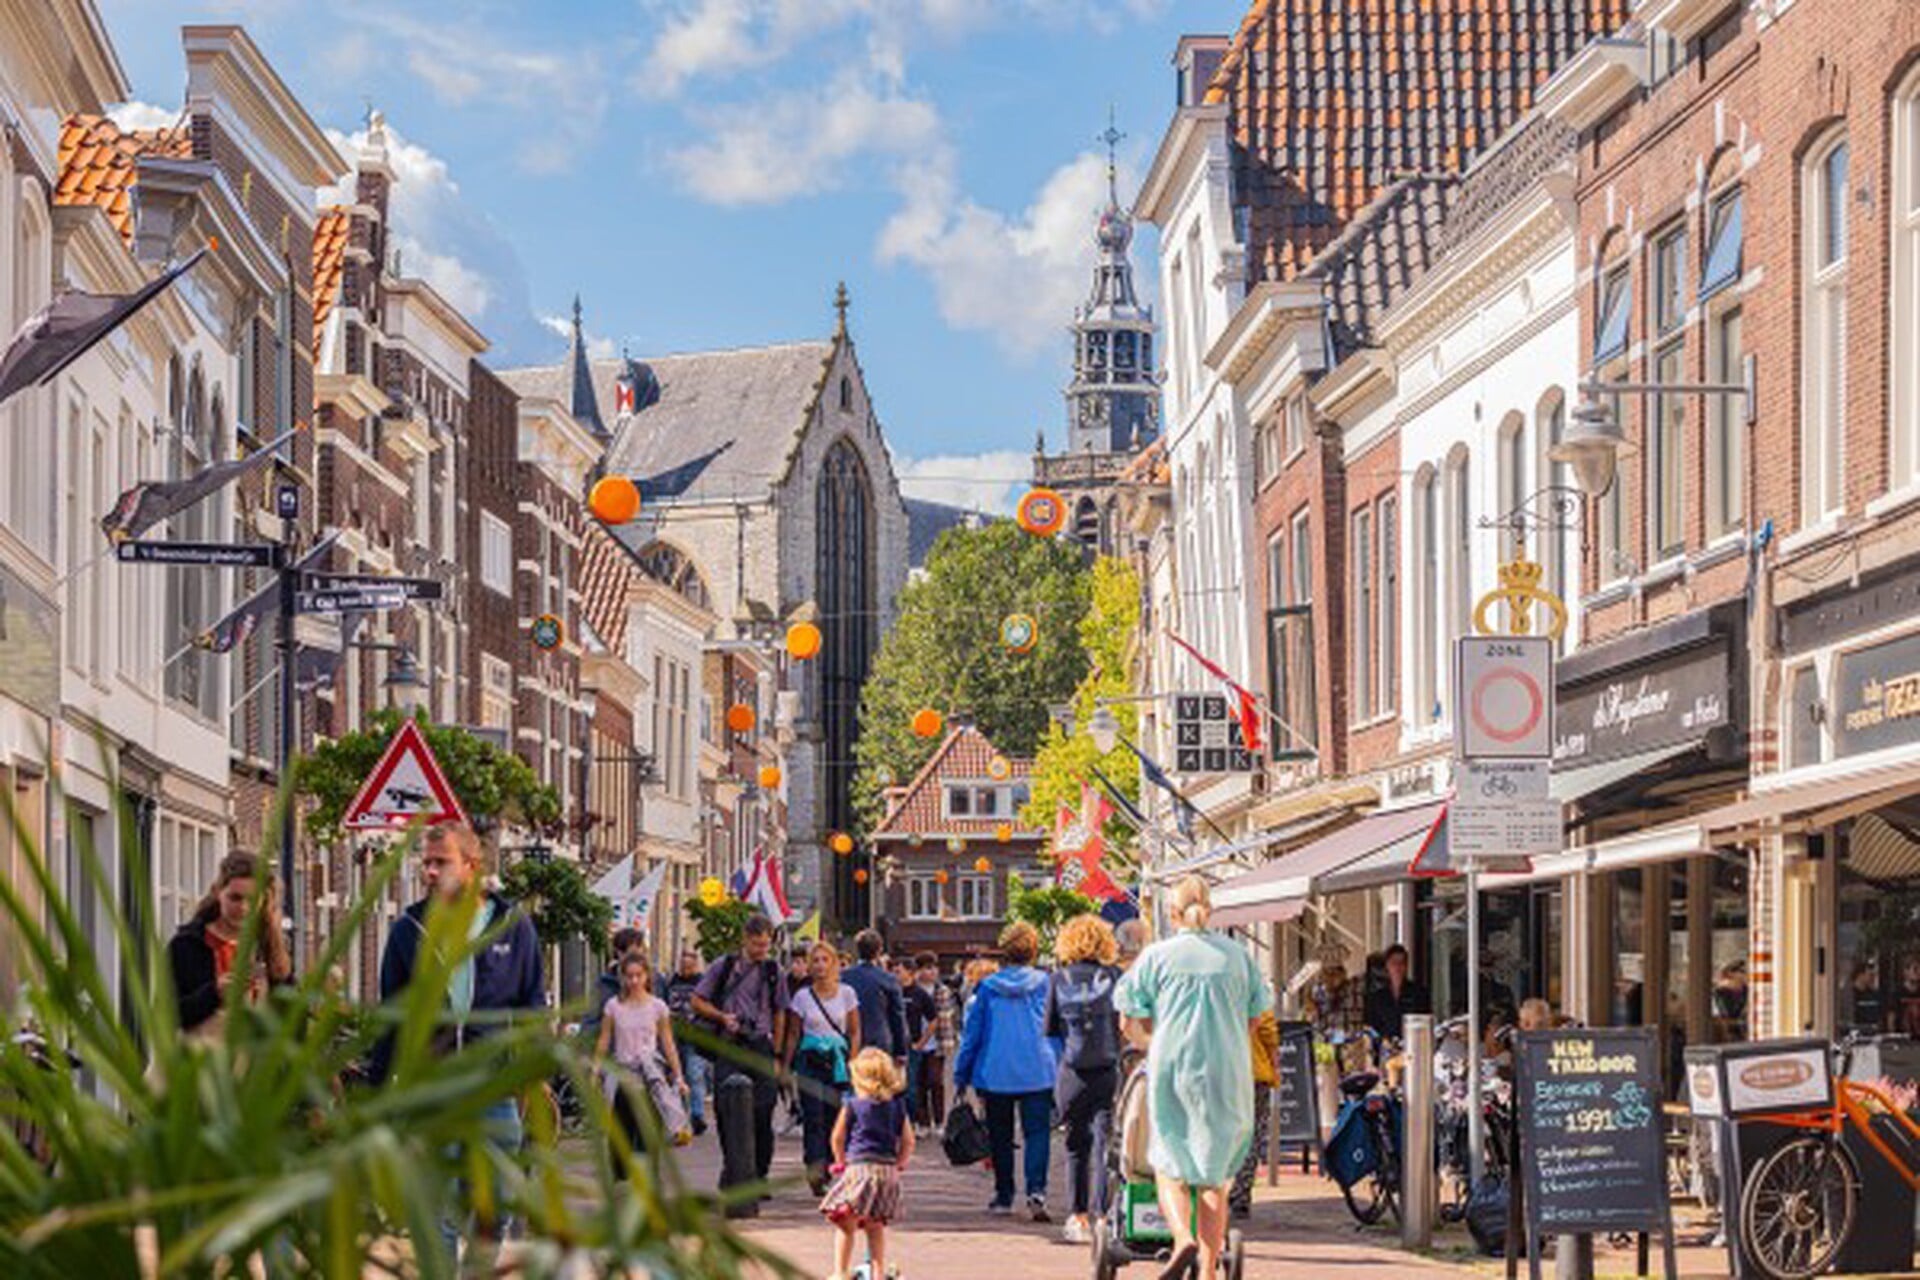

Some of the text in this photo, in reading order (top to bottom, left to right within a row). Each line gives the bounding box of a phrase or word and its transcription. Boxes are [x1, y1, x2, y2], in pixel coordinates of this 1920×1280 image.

[1485, 644, 1525, 657] ZONE
[1552, 1039, 1595, 1057] NEW
[1547, 1055, 1637, 1075] TANDOOR
[1565, 1109, 1618, 1134] 1991
